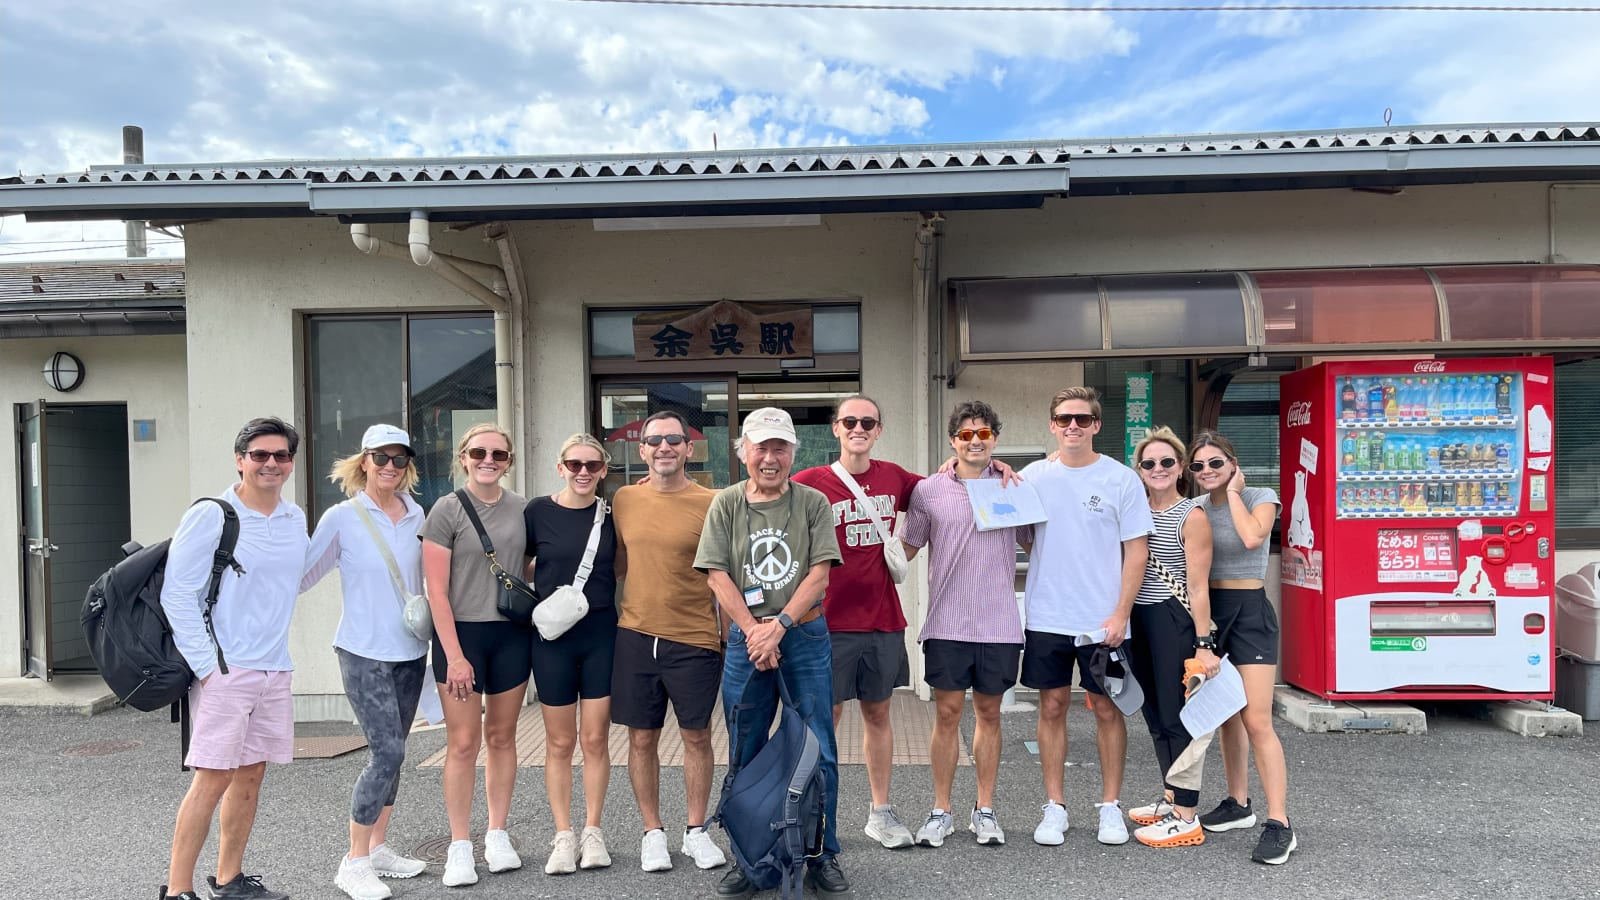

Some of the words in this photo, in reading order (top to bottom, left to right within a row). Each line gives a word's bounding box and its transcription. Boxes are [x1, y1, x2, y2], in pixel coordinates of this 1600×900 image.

[650, 321, 796, 358] 余呉駅
[1126, 377, 1149, 465] 警察官
[750, 528, 773, 541] BACK
[846, 518, 893, 547] STA
[774, 560, 800, 590] DEMAND
